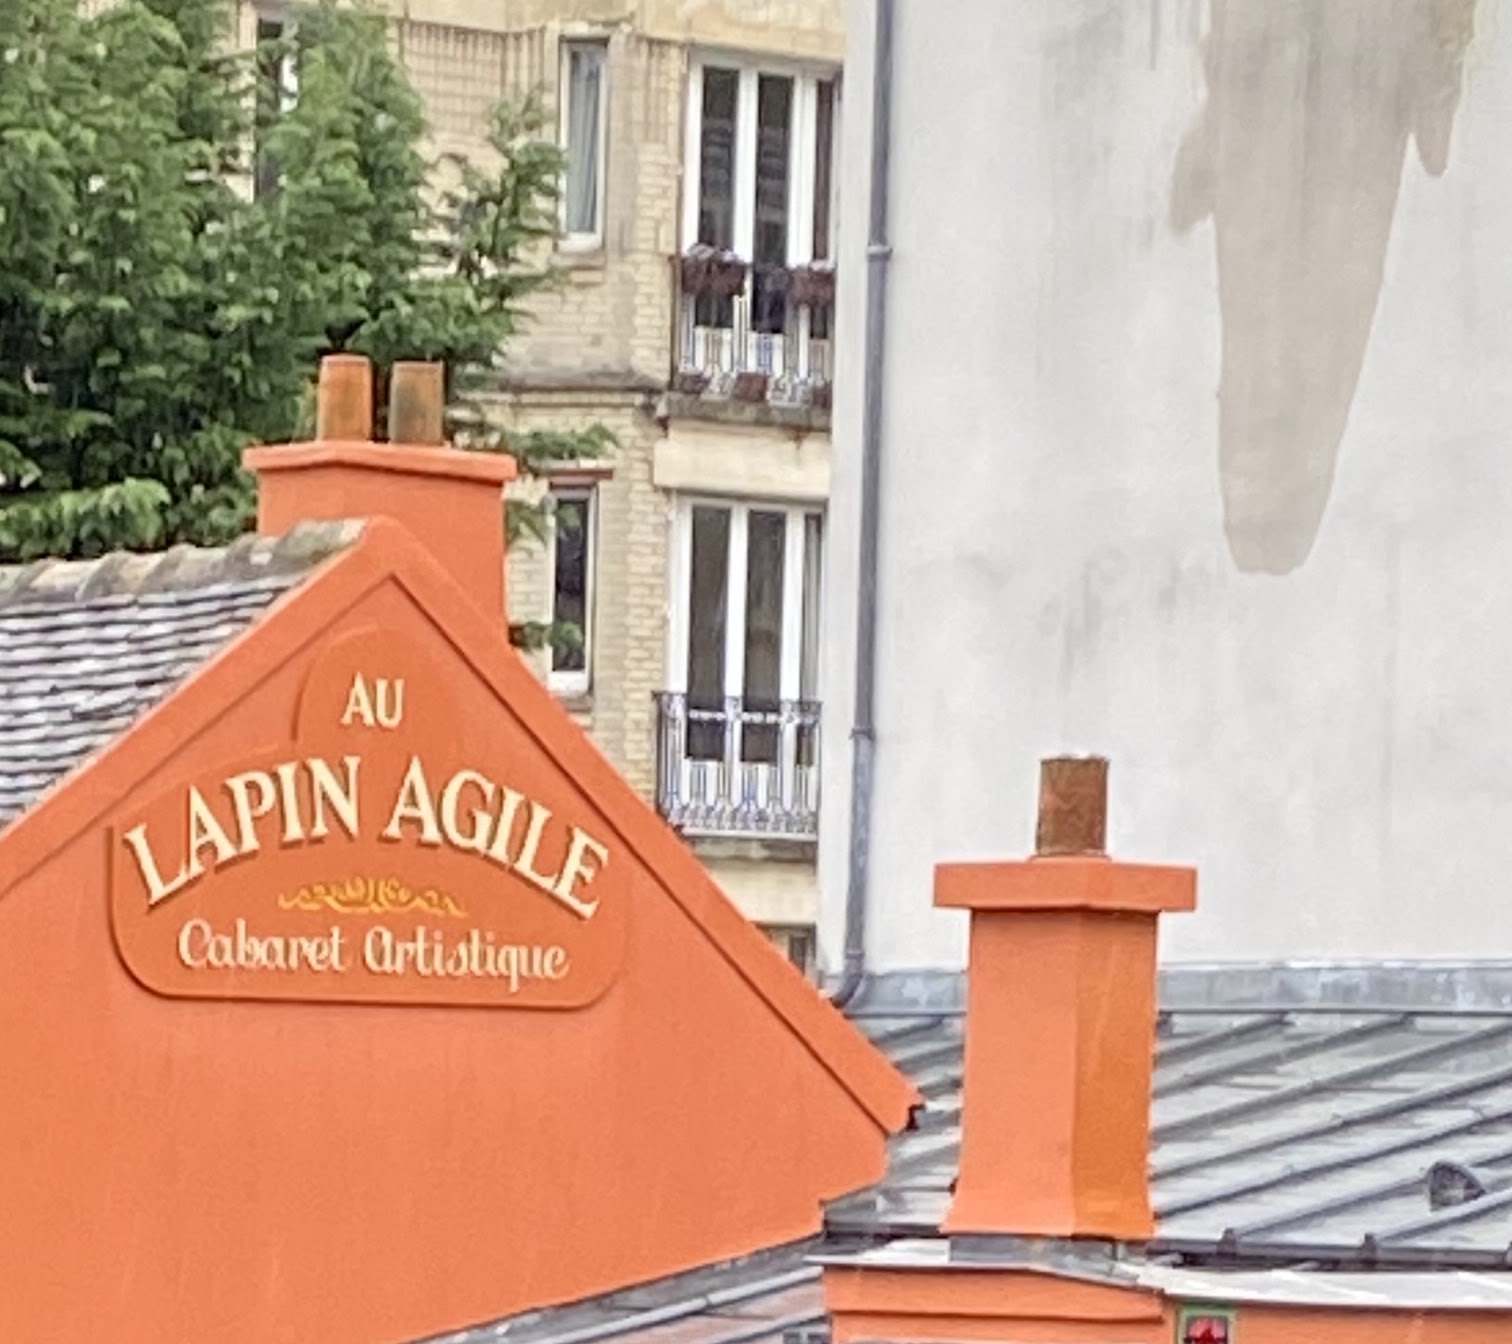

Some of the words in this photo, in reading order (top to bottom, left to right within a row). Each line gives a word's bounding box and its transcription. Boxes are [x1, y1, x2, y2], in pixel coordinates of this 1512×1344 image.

[341, 673, 404, 728] AU
[123, 755, 362, 906] LAPIN
[384, 755, 610, 920] AGILE
[178, 918, 348, 972] Cabaret
[363, 926, 570, 993] Artistique
